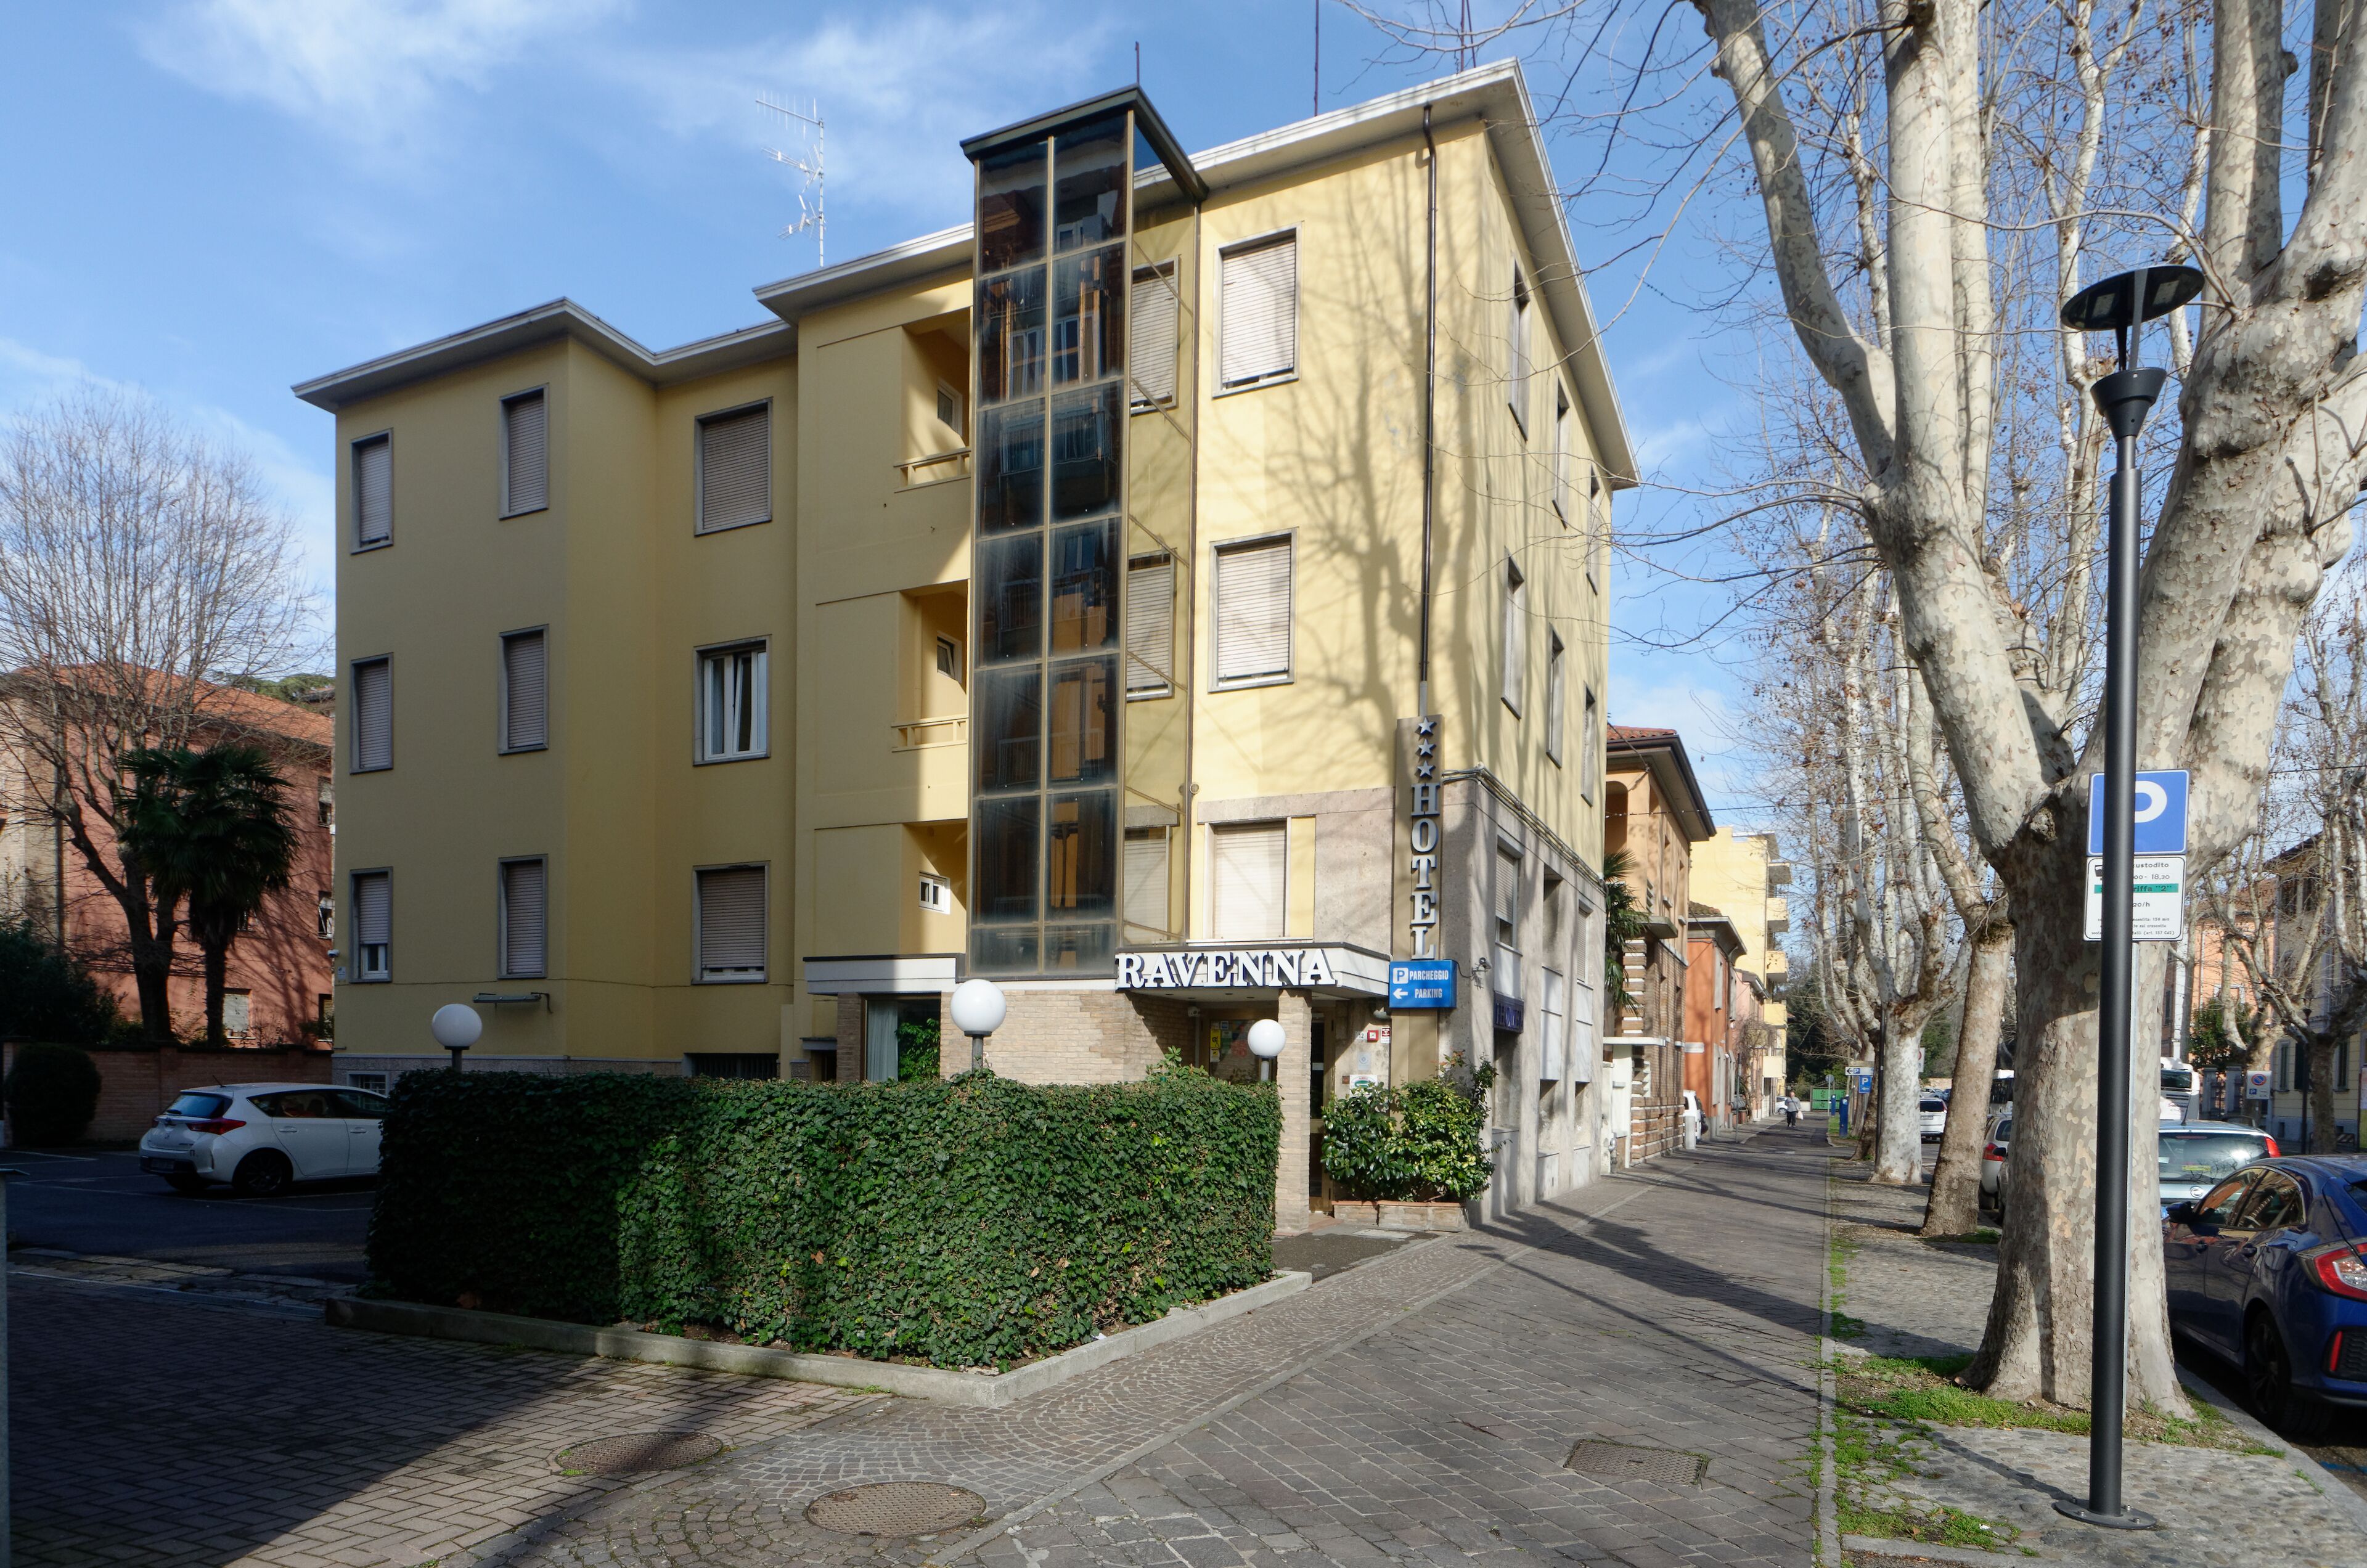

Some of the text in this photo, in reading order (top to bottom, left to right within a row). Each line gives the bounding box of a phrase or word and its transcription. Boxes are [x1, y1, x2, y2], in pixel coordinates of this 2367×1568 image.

[1410, 782, 1441, 960] HOTEL
[1115, 949, 1336, 989] RAVENNA
[1397, 970, 1449, 981] P PARCHEGGIO
[1415, 988, 1442, 998] PARKING
